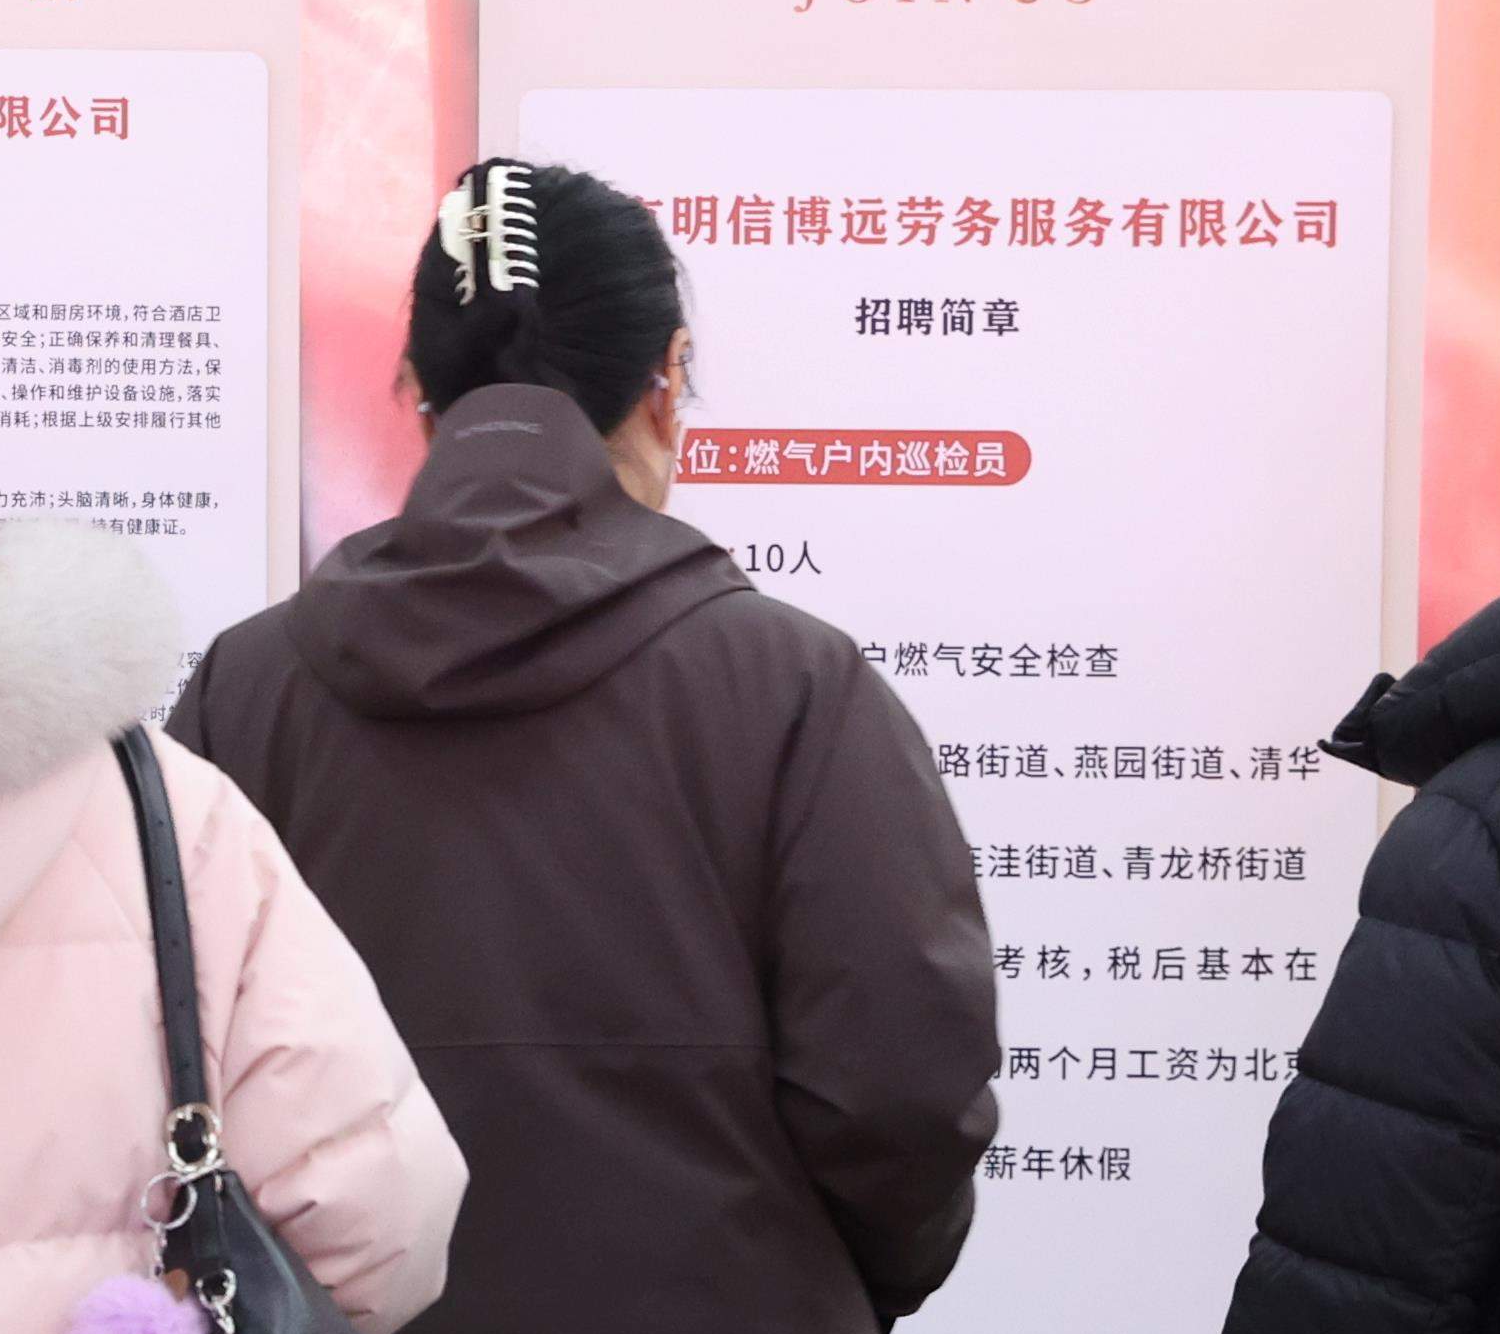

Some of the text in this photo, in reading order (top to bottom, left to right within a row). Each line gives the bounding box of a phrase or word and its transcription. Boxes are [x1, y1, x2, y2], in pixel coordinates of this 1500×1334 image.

[854, 297, 1020, 337] 招聘简章
[937, 744, 1321, 781] 路街道、燕园街道、清华
[993, 943, 1319, 982] 考核，税后基本在
